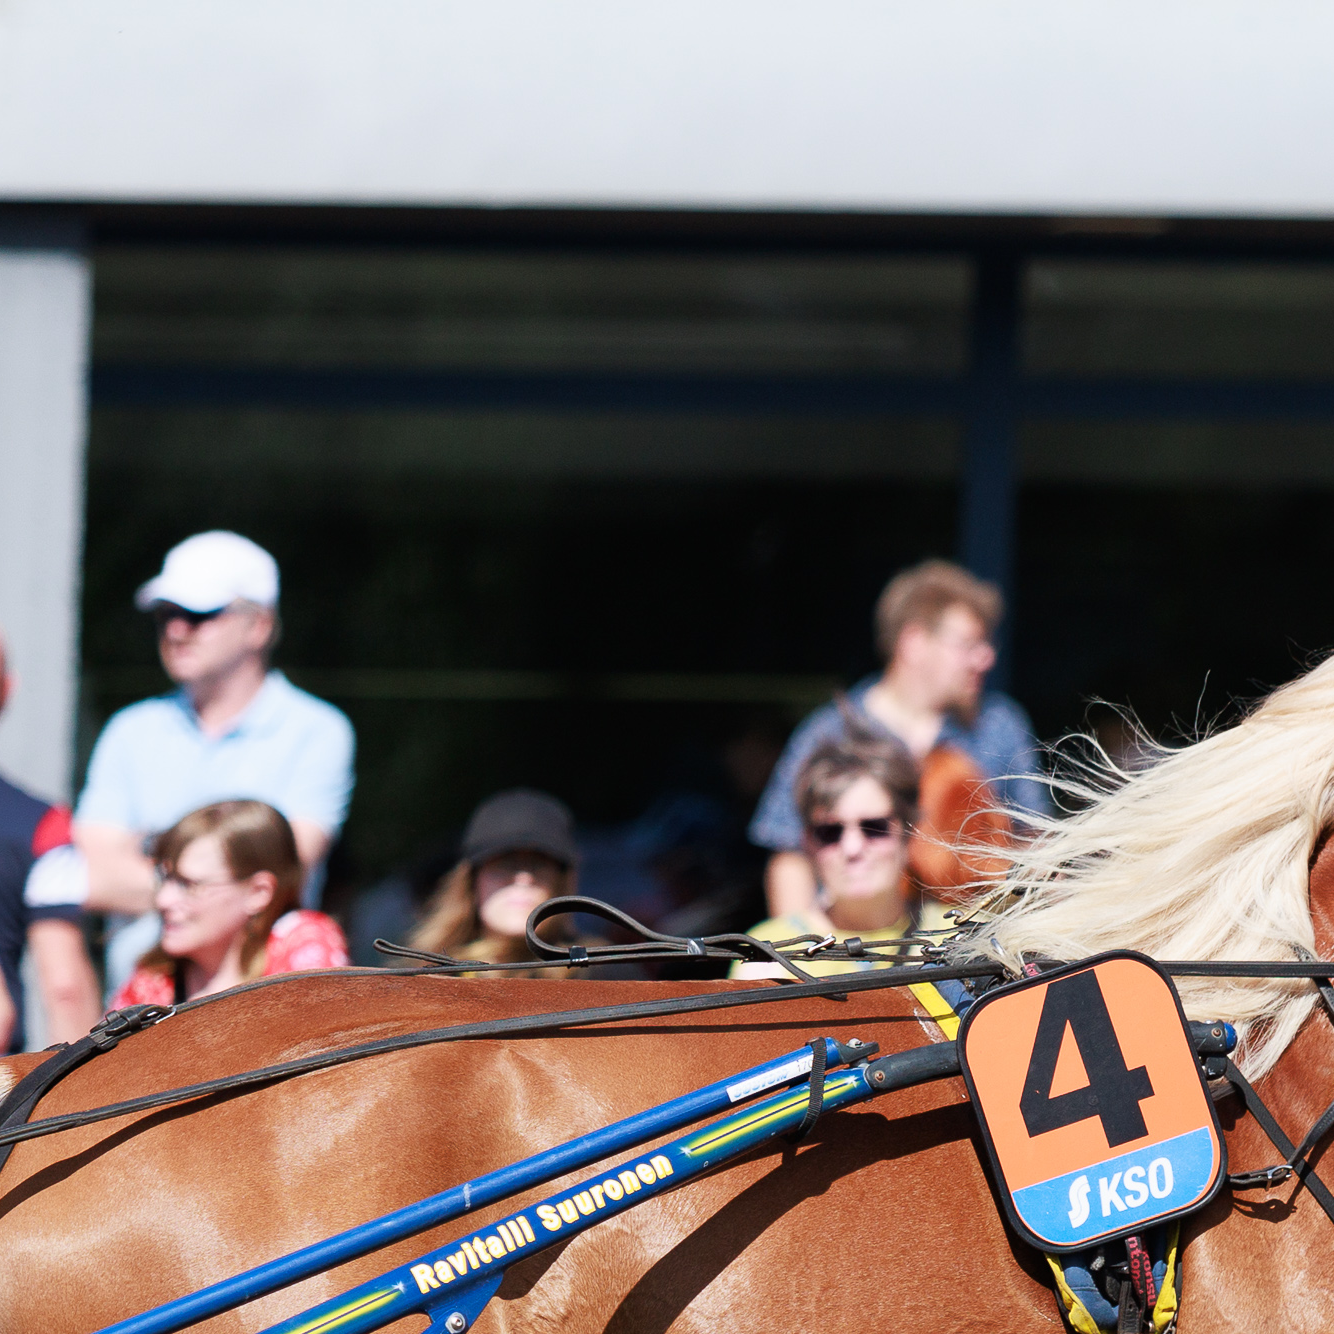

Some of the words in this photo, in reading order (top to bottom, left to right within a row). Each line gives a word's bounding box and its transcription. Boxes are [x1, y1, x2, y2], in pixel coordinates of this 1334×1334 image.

[1019, 968, 1156, 1149] 4
[410, 1215, 536, 1294] Ravitalli
[536, 1154, 674, 1232] Suuronen
[1099, 1157, 1174, 1218] KSO
